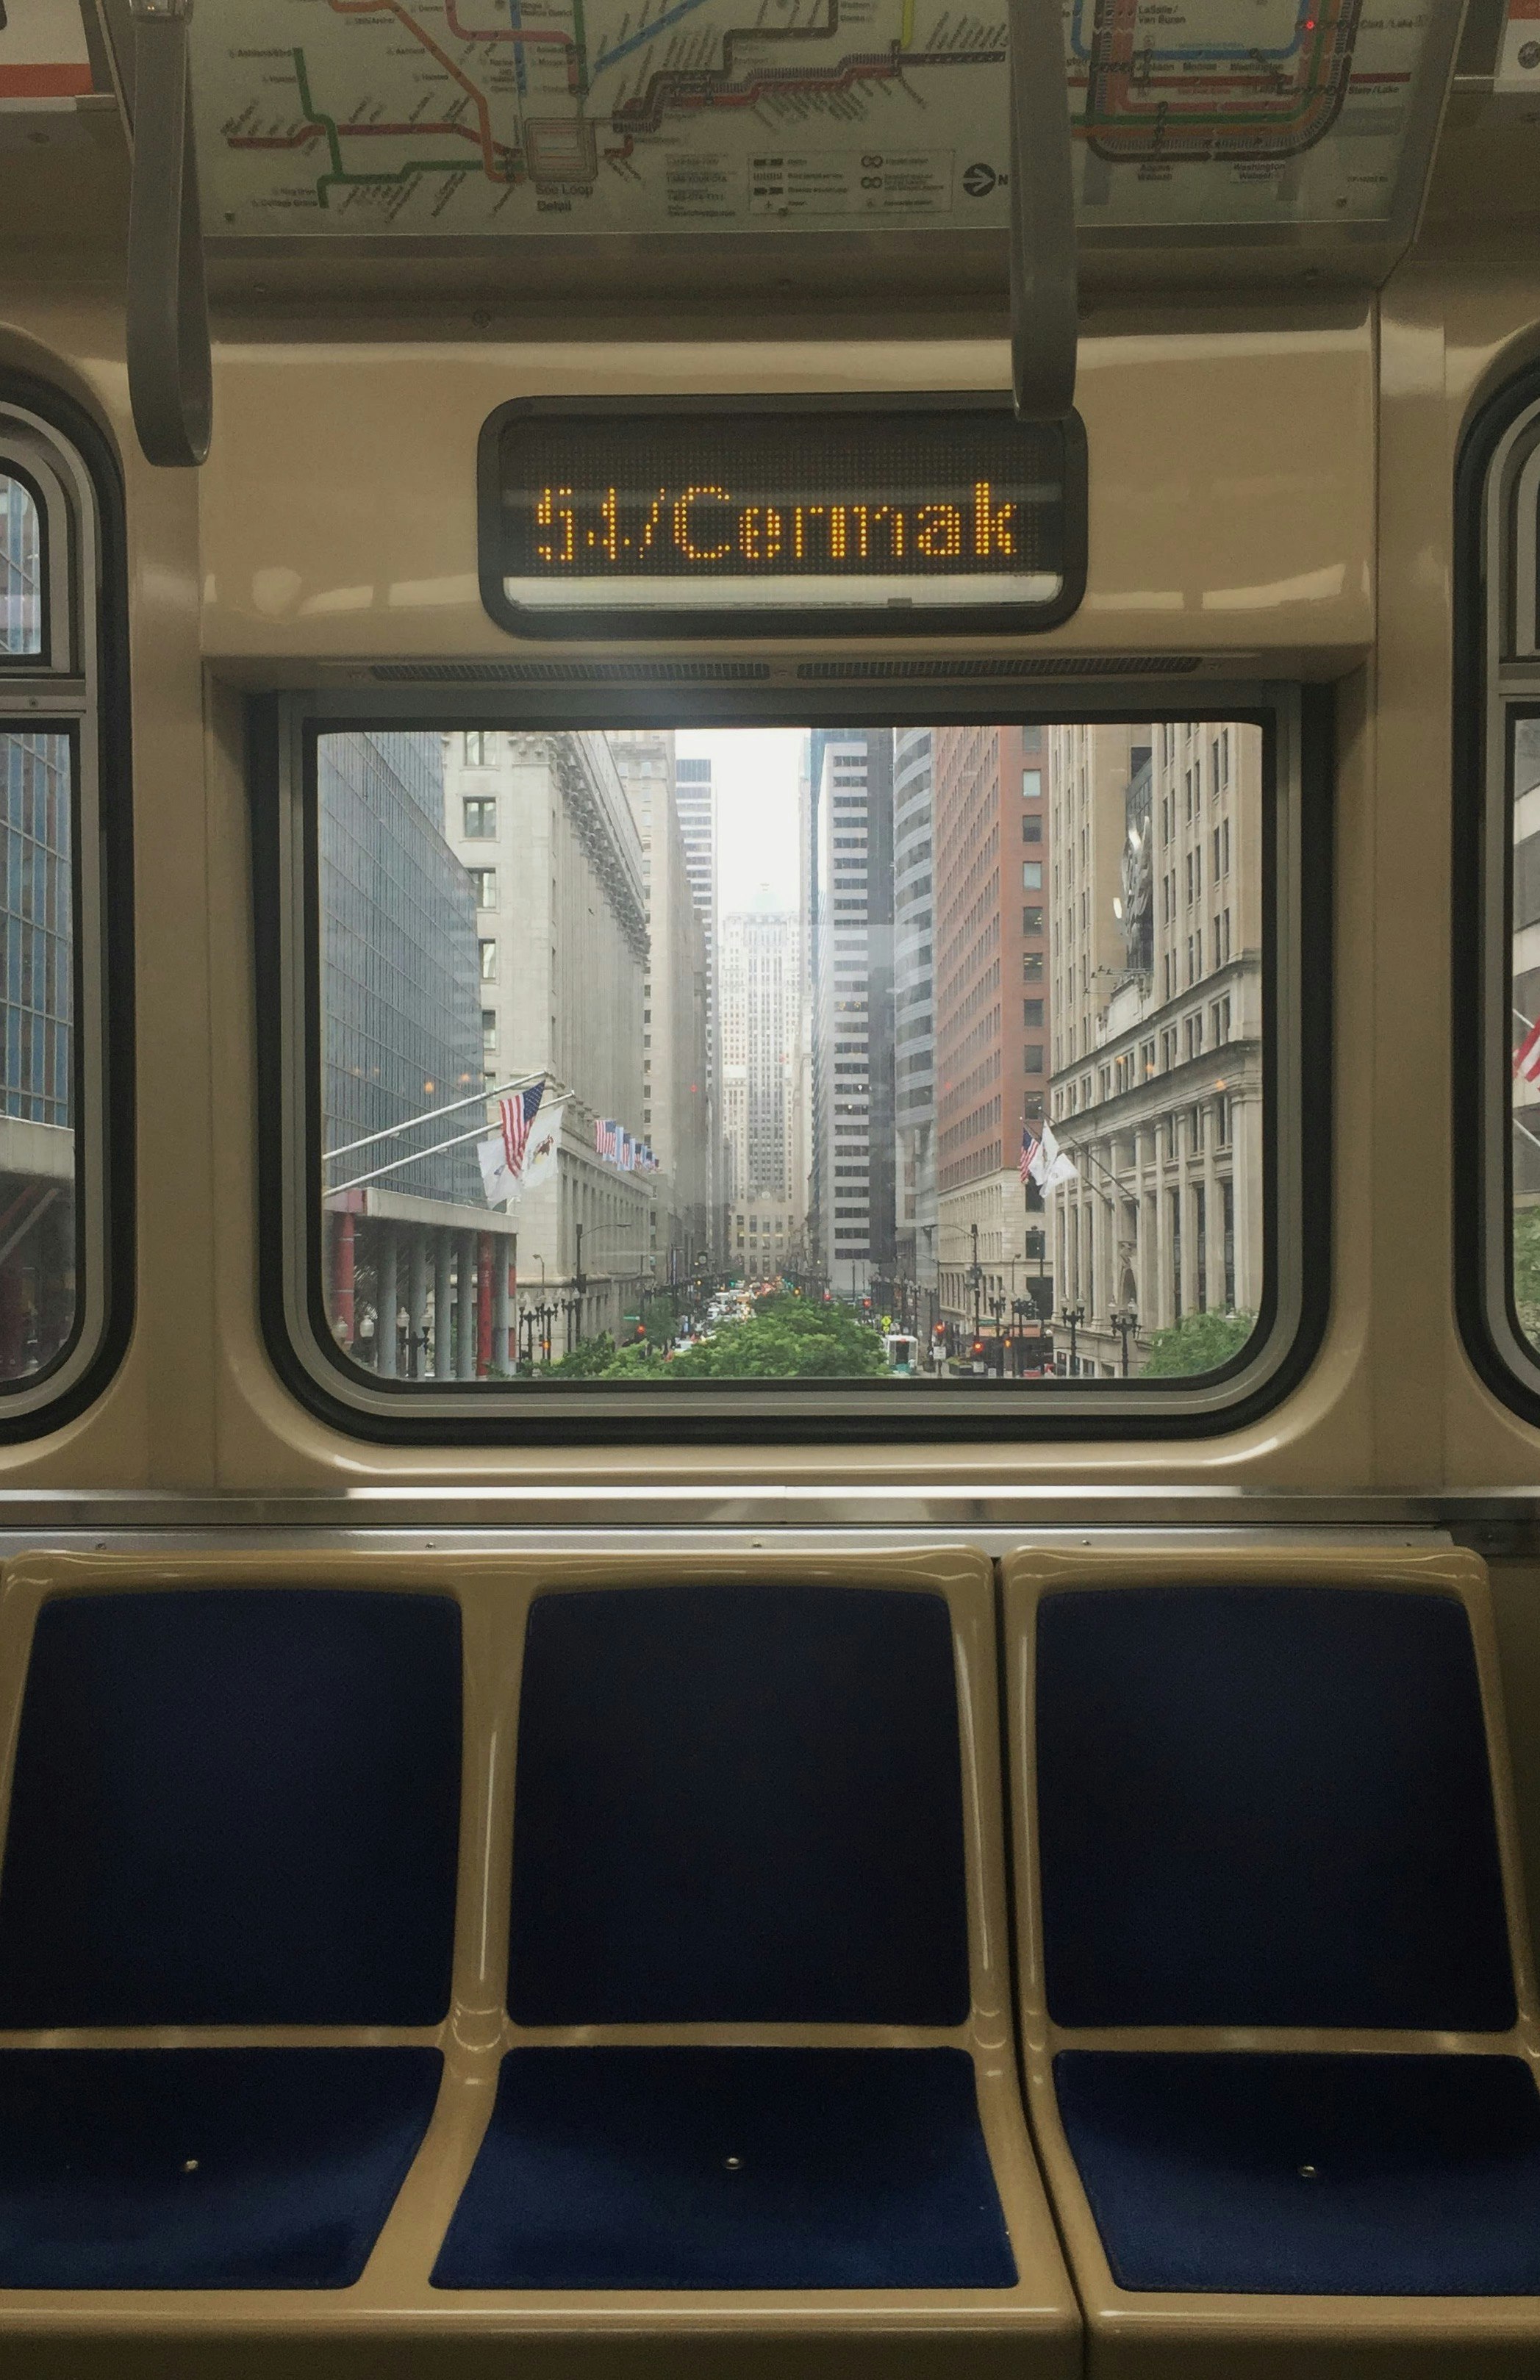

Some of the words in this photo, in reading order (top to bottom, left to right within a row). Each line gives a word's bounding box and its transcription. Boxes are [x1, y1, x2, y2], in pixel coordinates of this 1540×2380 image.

[998, 174, 1009, 186] N
[562, 183, 594, 198] Loop
[537, 200, 573, 212] Detail
[537, 481, 1018, 562] 54/Cermak
